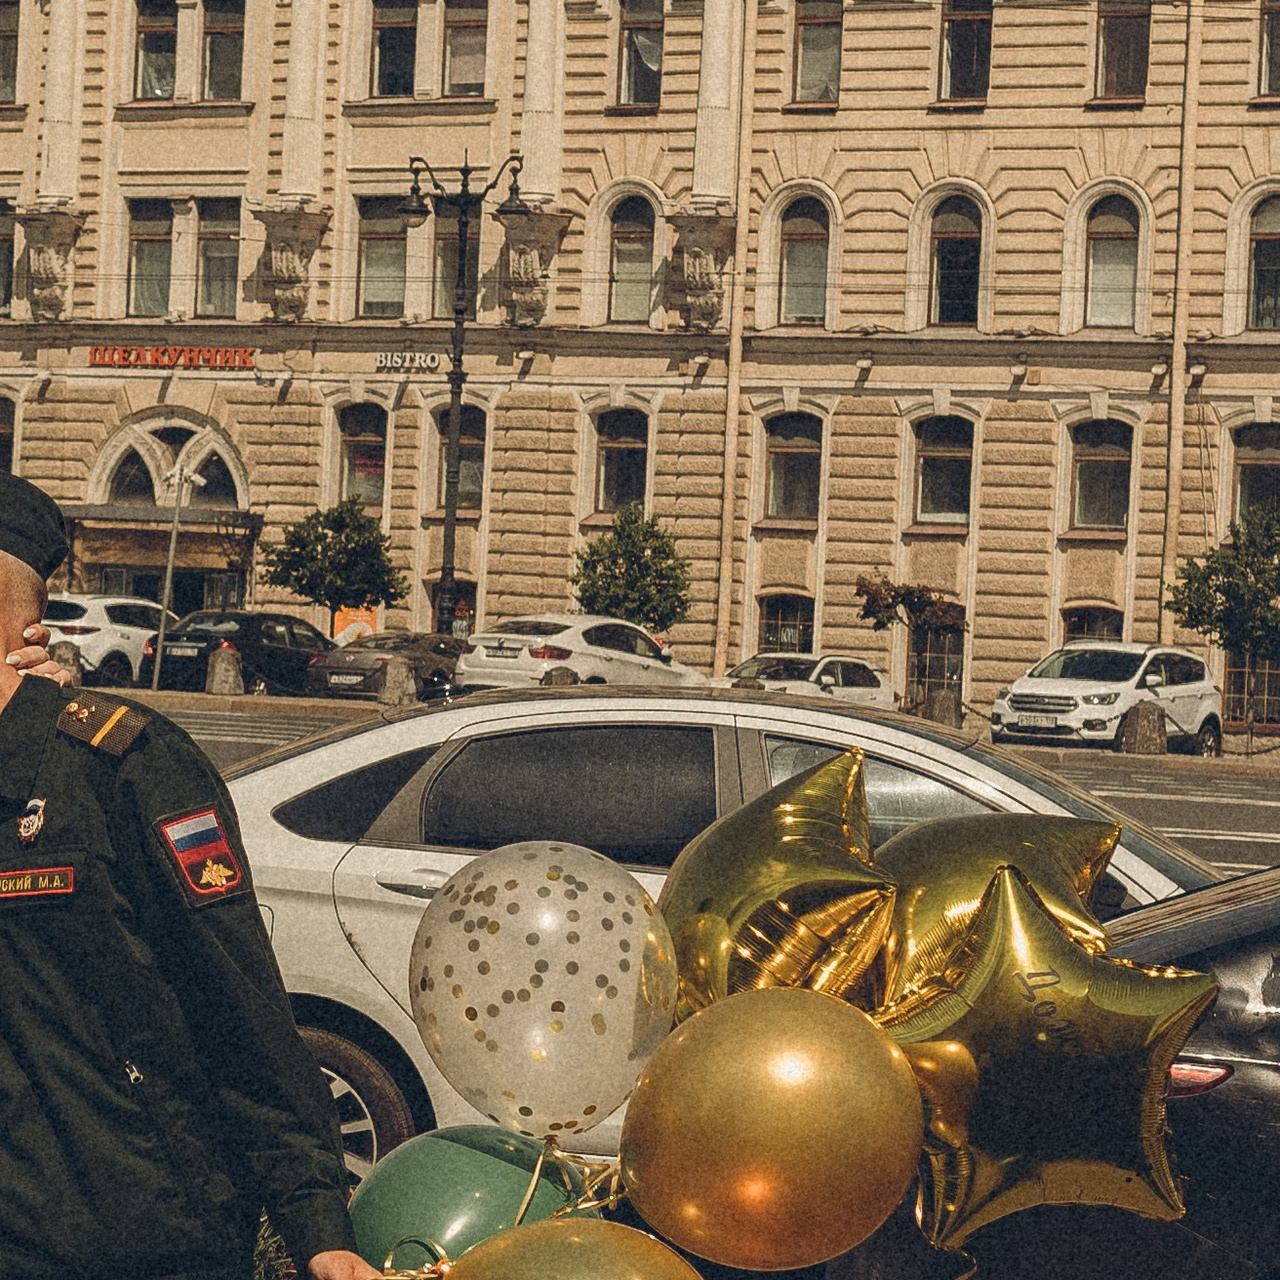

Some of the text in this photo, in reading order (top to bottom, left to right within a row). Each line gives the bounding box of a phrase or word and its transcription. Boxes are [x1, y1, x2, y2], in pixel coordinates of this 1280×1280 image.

[89, 345, 256, 367] ЩЕЛКУНЧИК
[376, 352, 440, 368] BISTRO
[38, 875, 64, 889] М.А.
